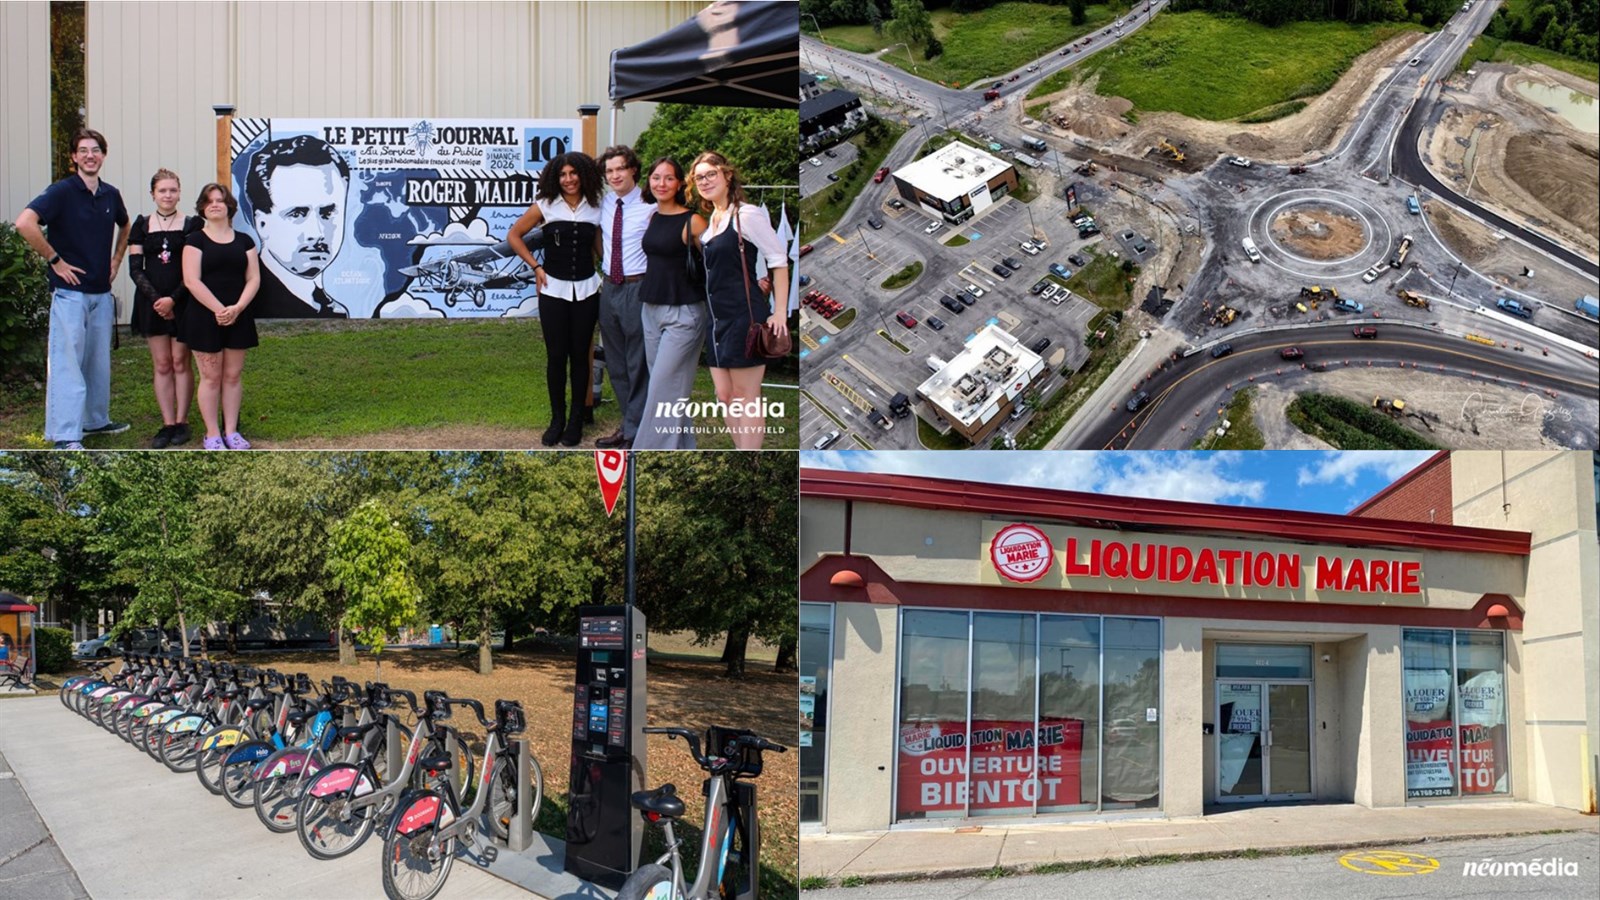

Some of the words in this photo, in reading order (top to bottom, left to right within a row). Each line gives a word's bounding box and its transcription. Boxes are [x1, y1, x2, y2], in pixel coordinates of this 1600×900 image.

[324, 127, 346, 144] LE
[351, 127, 409, 145] PETIT
[432, 126, 518, 145] JOURNAL
[360, 146, 378, 155] Au
[380, 146, 416, 156] Service
[437, 146, 450, 156] du
[452, 146, 483, 156] Public
[490, 160, 514, 169] 2026
[408, 180, 466, 203] ROGER
[1007, 549, 1039, 562] MARIE
[1065, 537, 1300, 588] LIQUIDATION
[1316, 556, 1421, 594] MARIE
[1006, 724, 1064, 750] MARIE
[920, 756, 1062, 775] OUVERTURE
[921, 772, 1062, 806] BIENTÔT
